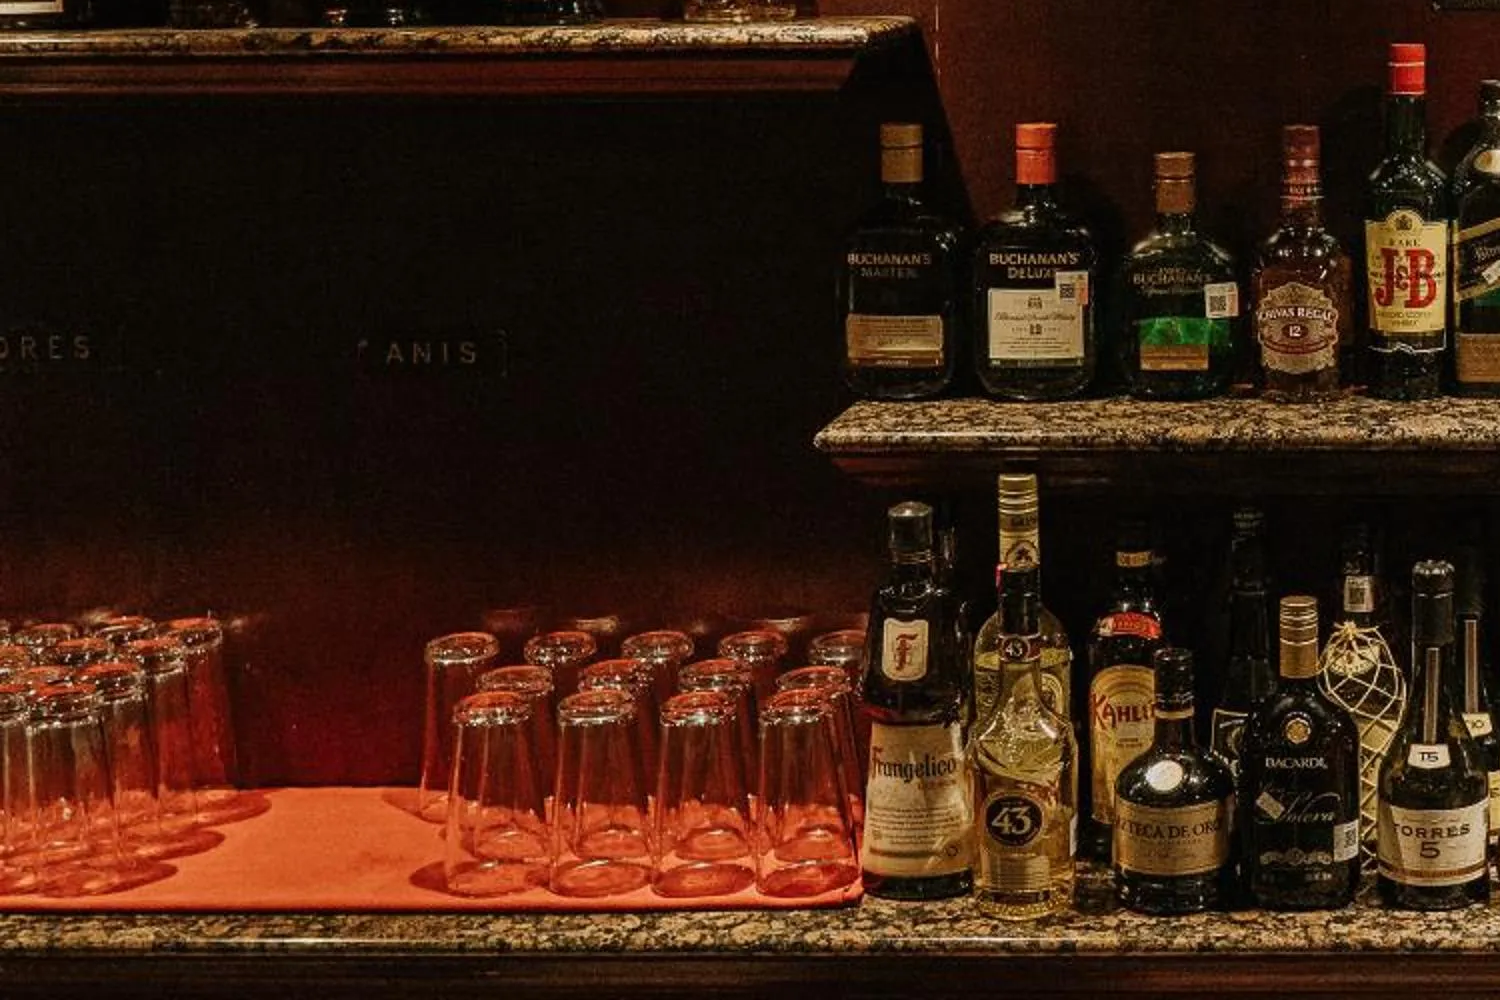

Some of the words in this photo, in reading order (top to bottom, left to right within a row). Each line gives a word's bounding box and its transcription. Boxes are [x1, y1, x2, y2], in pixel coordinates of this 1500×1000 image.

[847, 253, 933, 265] BUCHANAN'S
[989, 251, 1080, 265] BUCHANAN'S
[1289, 325, 1301, 337] 12
[385, 342, 478, 364] ANIS
[871, 746, 958, 783] Frangelico
[991, 806, 1033, 836] 43
[1167, 825, 1191, 838] DE
[1394, 823, 1471, 839] TORRES
[1419, 841, 1441, 859] 5
